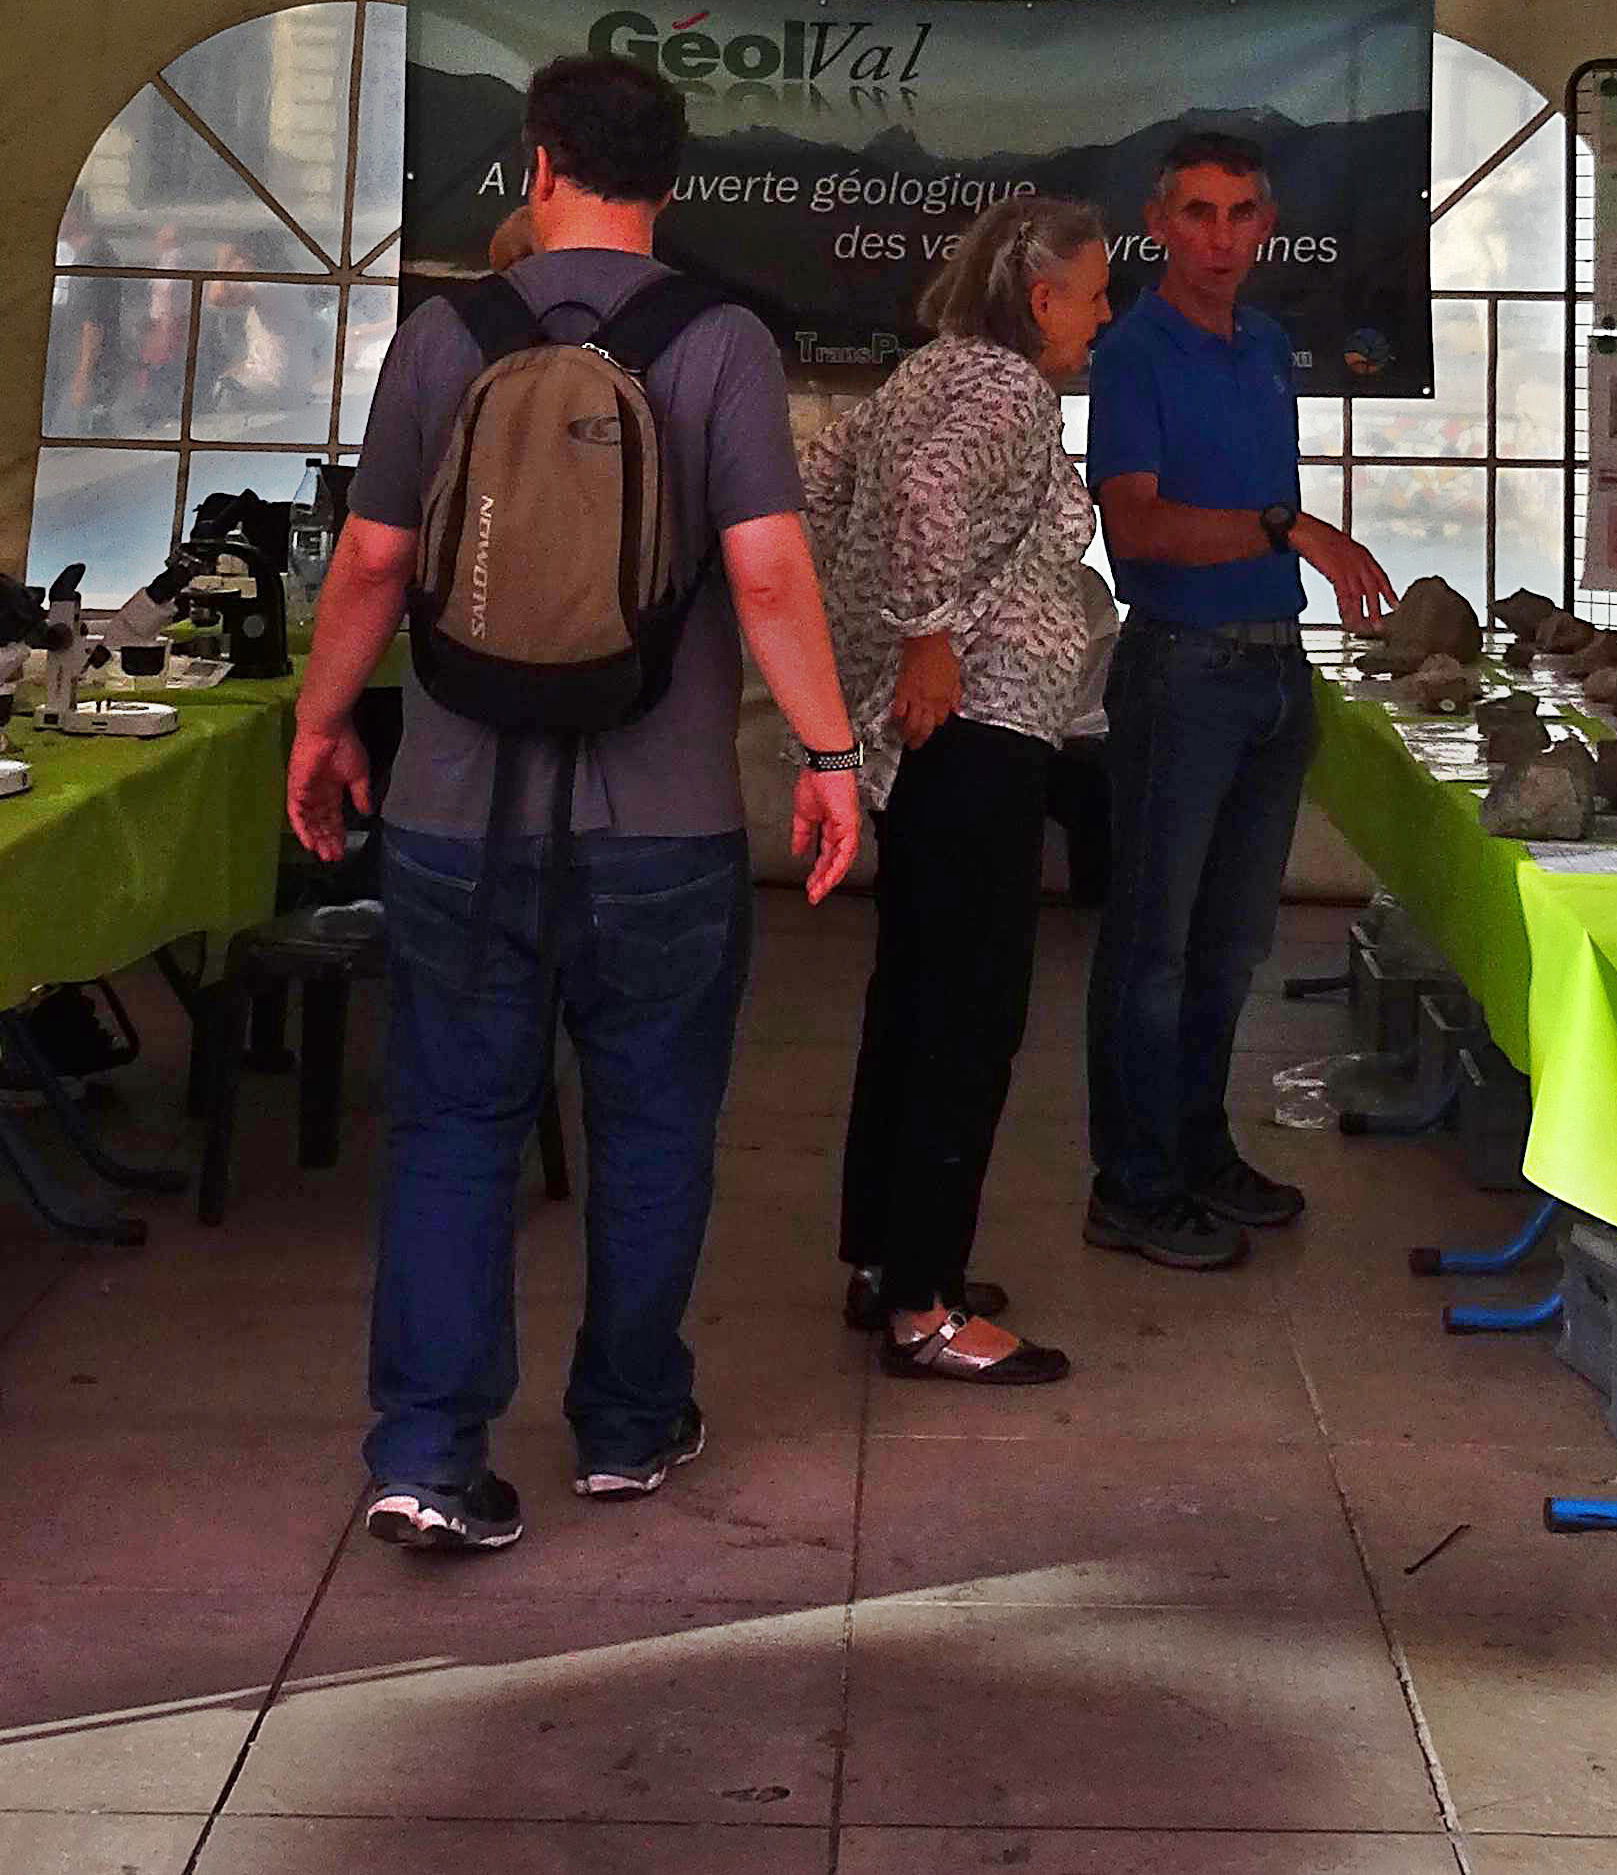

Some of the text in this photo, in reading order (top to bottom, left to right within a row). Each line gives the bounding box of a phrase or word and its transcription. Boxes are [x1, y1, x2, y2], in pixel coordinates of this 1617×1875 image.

[588, 10, 932, 82] GéolVal
[479, 162, 506, 196] A
[812, 169, 1036, 215] géologique
[835, 225, 906, 260] des
